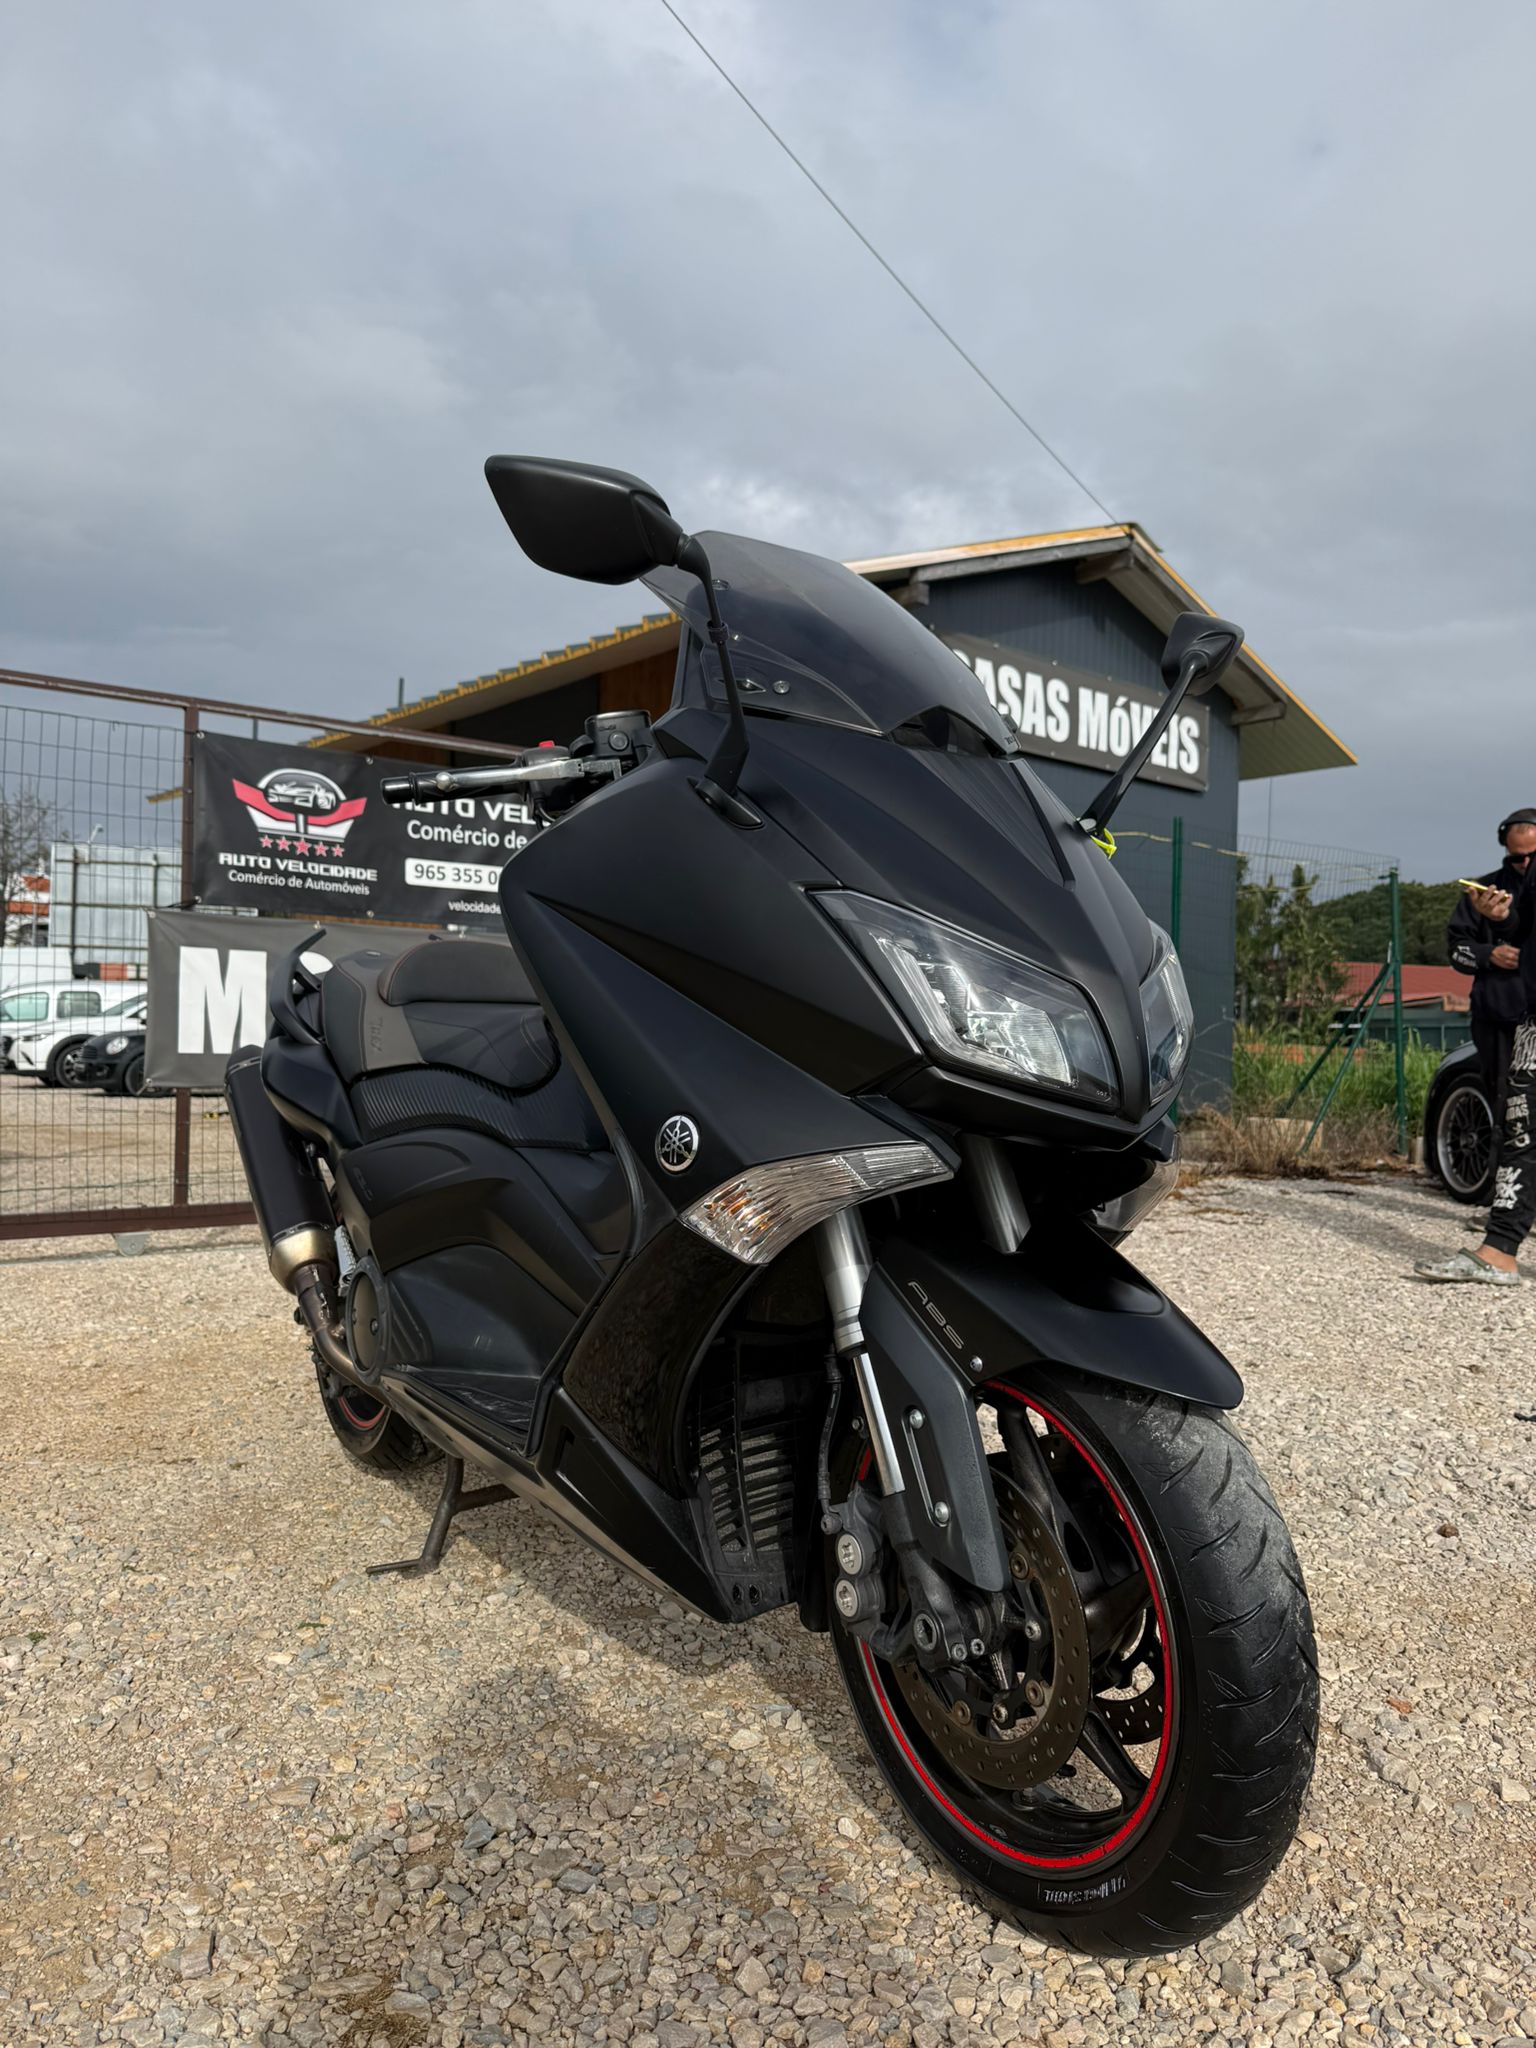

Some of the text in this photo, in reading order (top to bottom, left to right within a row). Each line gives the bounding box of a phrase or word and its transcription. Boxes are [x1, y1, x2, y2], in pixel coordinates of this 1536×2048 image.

[952, 648, 1071, 743] ASAS
[406, 818, 528, 849] Comércio de
[218, 852, 378, 882] AUTO VELOCIDADE
[414, 863, 447, 882] 965
[451, 866, 483, 884] 355
[228, 869, 371, 896] Comércio de Automóveis
[907, 1281, 965, 1350] ABS
